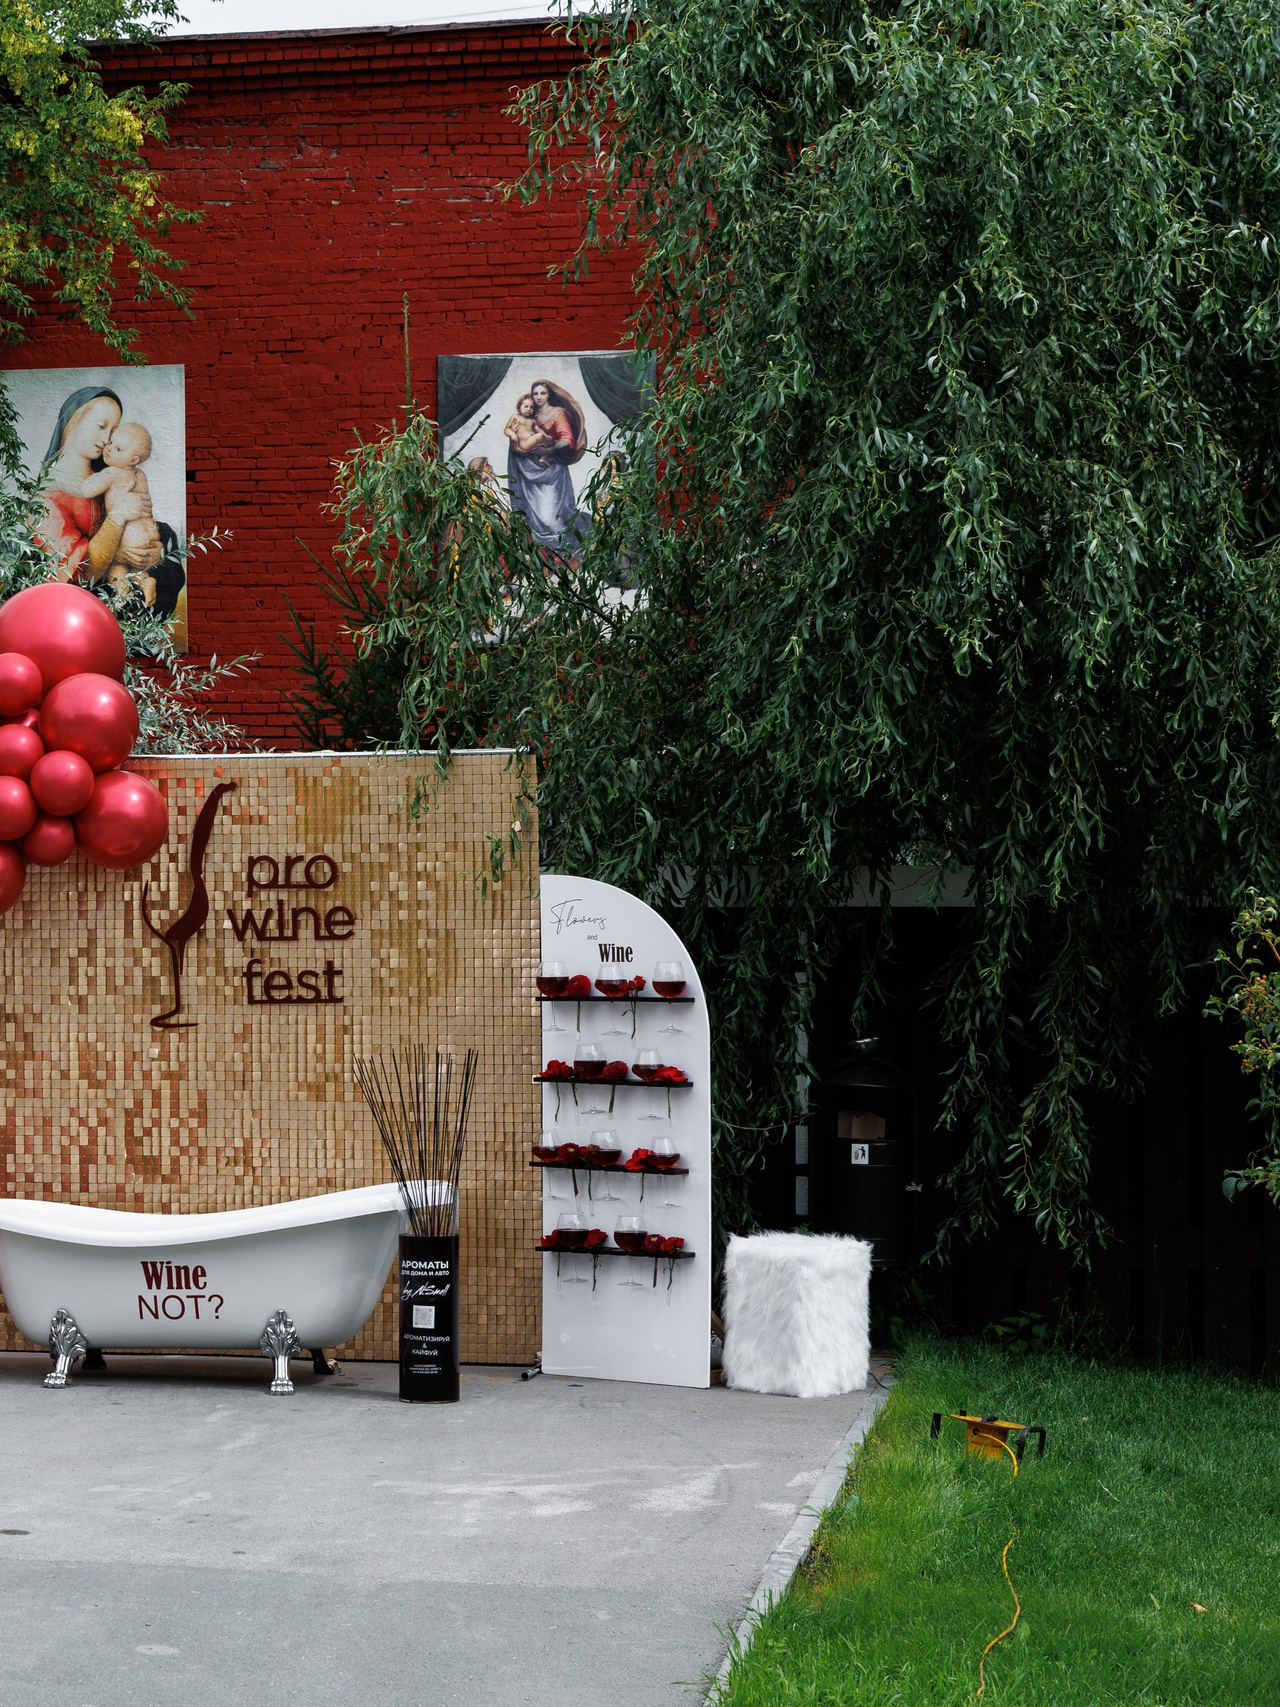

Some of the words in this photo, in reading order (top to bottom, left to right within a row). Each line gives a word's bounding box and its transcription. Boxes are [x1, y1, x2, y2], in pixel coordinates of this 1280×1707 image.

[248, 854, 339, 898] pro
[226, 899, 356, 942] wine
[586, 933, 598, 941] and
[598, 943, 634, 963] Wine
[242, 958, 344, 1005] fest
[140, 1260, 207, 1290] Wine
[401, 1260, 449, 1269] АРОМАТЫ
[137, 1294, 224, 1320] NOT?
[403, 1333, 451, 1342] АРОМАТИЗИРУЙ
[411, 1348, 439, 1356] КАЙФУЙ
